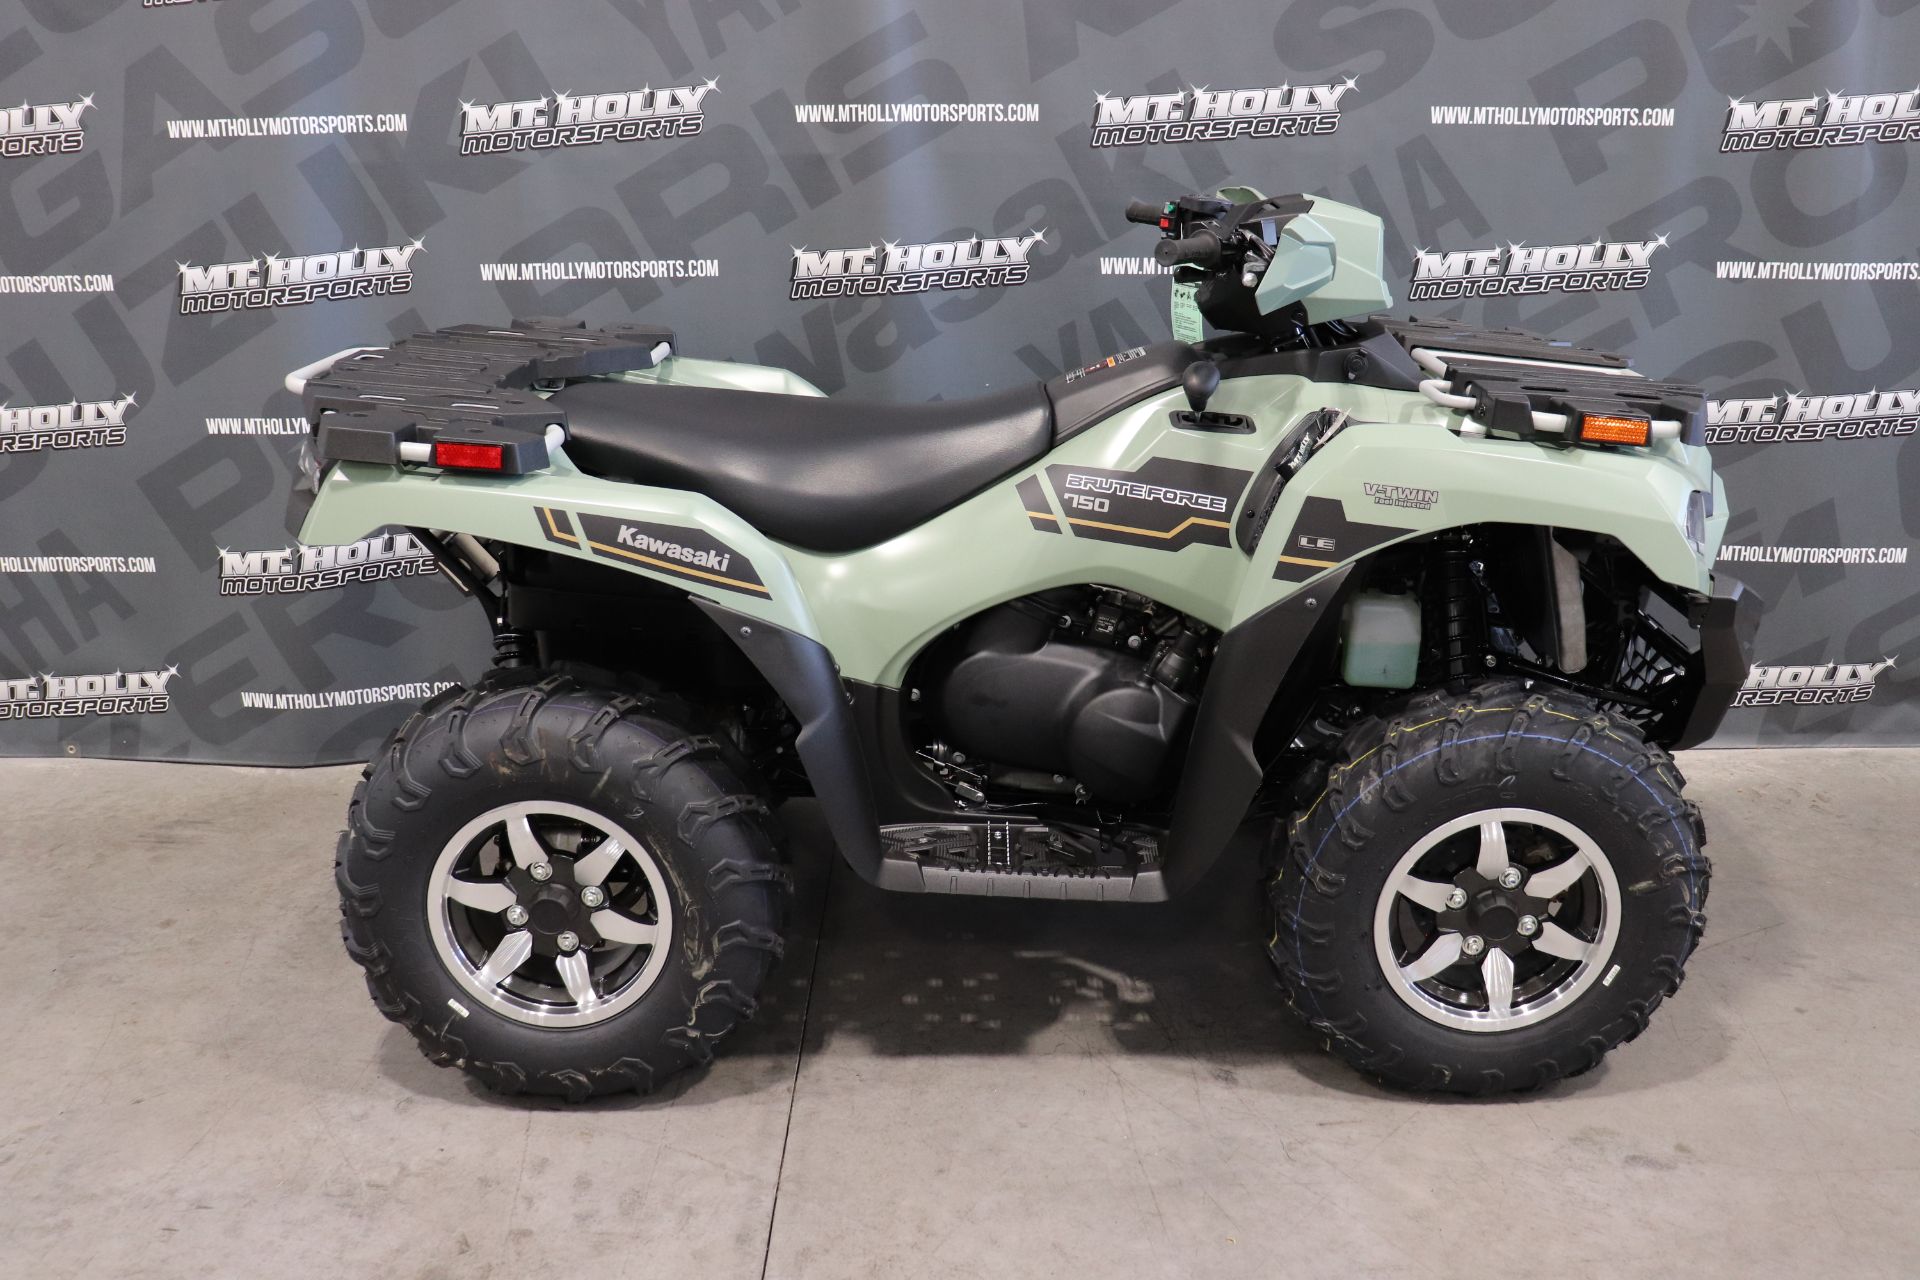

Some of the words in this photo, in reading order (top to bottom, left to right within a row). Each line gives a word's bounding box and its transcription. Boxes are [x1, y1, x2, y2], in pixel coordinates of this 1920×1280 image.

[0, 102, 86, 136] LLY
[464, 98, 549, 134] MT.
[554, 86, 709, 125] HOLLY
[795, 103, 1039, 122] WWW.MTHOLLYMOTORSPORTS.COM
[1096, 93, 1184, 126] MT.
[1190, 85, 1348, 121] HOLLY
[1431, 105, 1675, 126] WWW.MTHOLLYMOTORSPORTS.COM
[1726, 99, 1818, 131] MT.
[167, 113, 407, 138] WWW.MTHOLLYMOTORSPORTS.COM
[461, 114, 704, 155] MOTORSPORTS
[1092, 113, 1341, 147] MOTORSPORTS
[0, 131, 84, 157] ORTS
[181, 262, 259, 294] MT.
[266, 246, 415, 286] HOLLY
[480, 259, 719, 281] WWW.MTHOLLYMOTORSPORTS.COM
[794, 248, 877, 279] MT.
[883, 237, 1036, 274] HOLLY
[1100, 257, 1173, 275] WWW.M
[1413, 249, 1500, 281] MT.
[1505, 240, 1659, 276] HOLLY
[0, 274, 114, 293] OTORSPORTS.COM
[180, 273, 413, 314] MOTORSPORTS
[791, 265, 1030, 299] MOTORSPORTS
[1409, 268, 1651, 300] MOTORSPORTS
[0, 400, 128, 434] HOLLY
[1064, 493, 1110, 513] 750
[1363, 483, 1439, 503] V-TWIN
[221, 550, 293, 577] MT.
[299, 532, 433, 573] HOLL
[617, 525, 730, 572] Kawasaki
[1299, 536, 1335, 550] LE
[0, 556, 156, 573] HOLLYMOTORSPORTS.COM
[221, 557, 438, 595] MOTORSPORTS
[0, 677, 39, 701] T.
[45, 671, 169, 699] HOLLY
[1741, 663, 1885, 690] HOLLY
[241, 682, 461, 710] WWW.MTHOLLYMOTORSPORTS.C
[1730, 685, 1875, 707] RSPORTS
